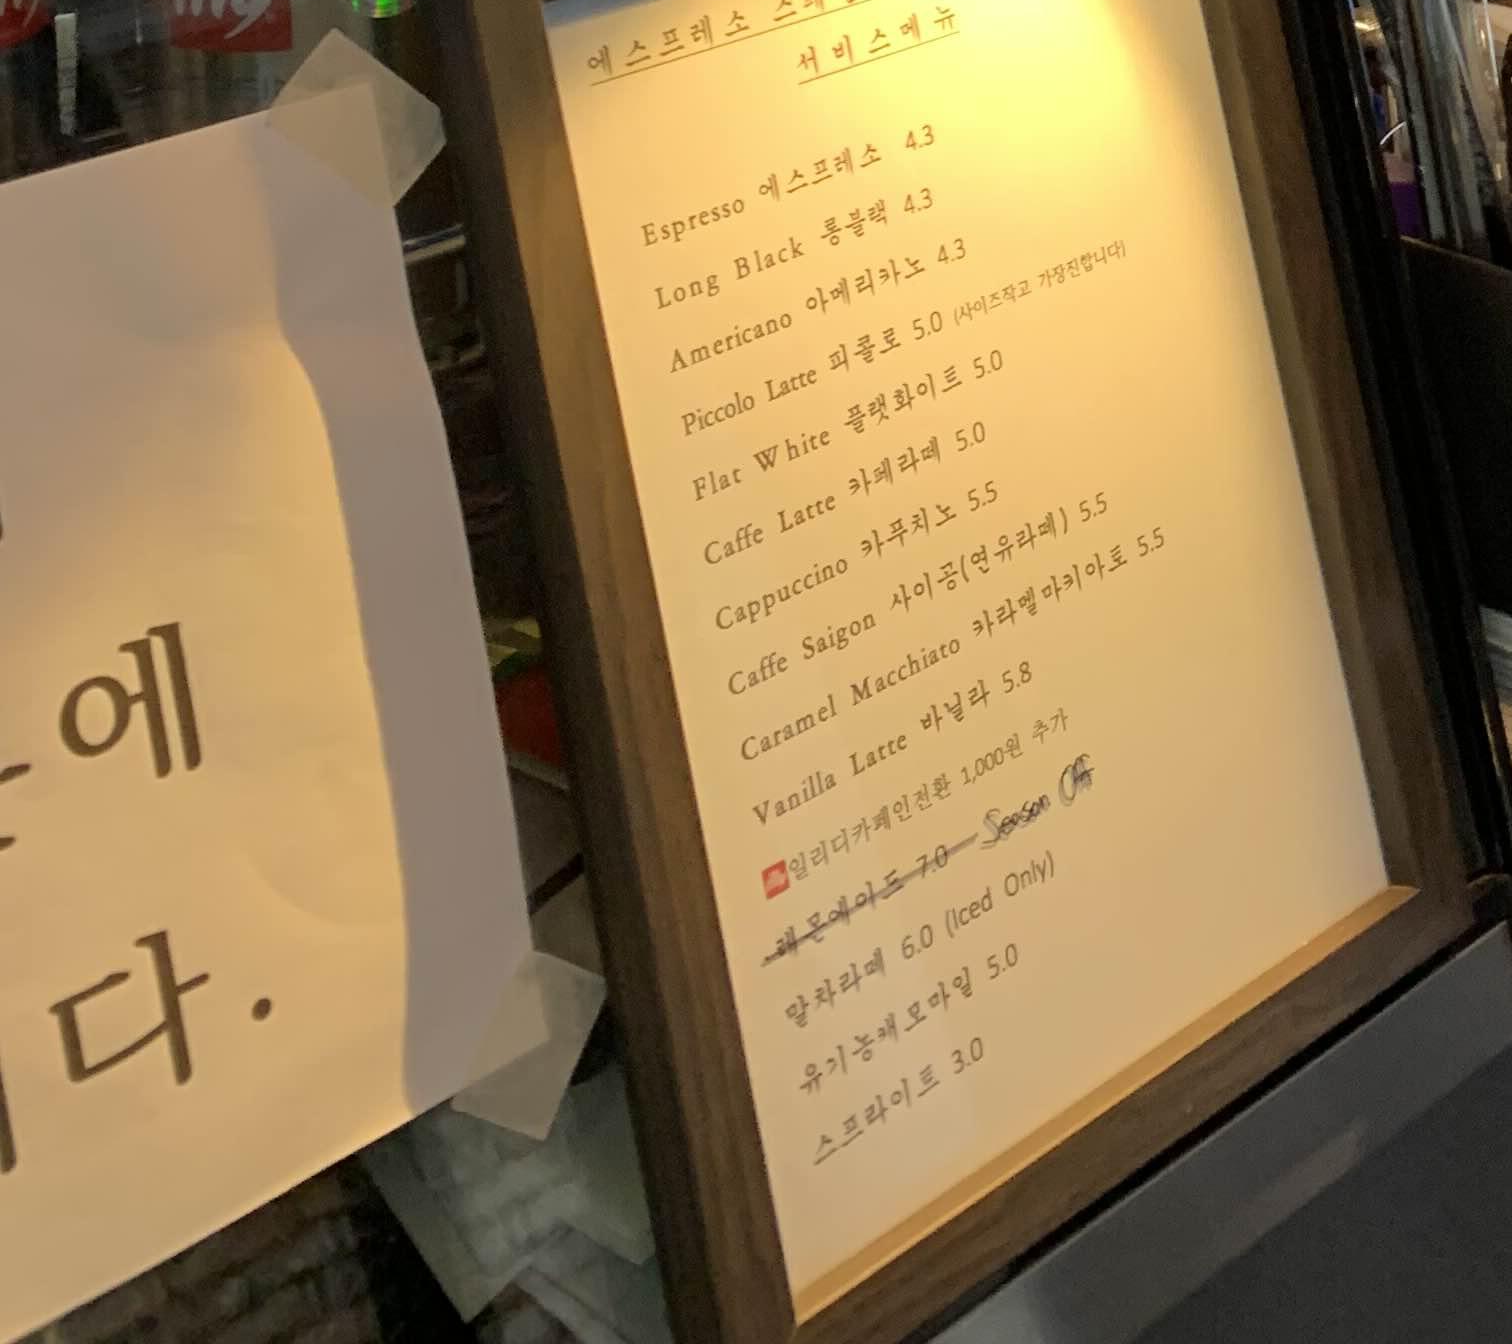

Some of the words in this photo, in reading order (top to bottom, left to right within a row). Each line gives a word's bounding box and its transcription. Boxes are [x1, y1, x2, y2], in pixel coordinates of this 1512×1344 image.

[586, 9, 751, 76] 에스프레소
[641, 199, 745, 247] Espresso
[758, 143, 882, 202] 에스프레소
[904, 124, 935, 151] 4.3
[654, 274, 721, 310] Long
[733, 237, 805, 281] Black
[820, 199, 887, 246] 롱블랙
[903, 187, 934, 214] 4.3
[670, 313, 793, 374] Americano
[805, 257, 926, 315] 아메리카노
[936, 238, 967, 265] 4.3
[681, 391, 756, 437] Piccolo
[763, 368, 818, 402] Latte
[827, 327, 902, 372] 피콜로
[912, 310, 944, 341] 5.0
[953, 279, 1033, 327] (사이즈작고
[692, 467, 743, 502] Flat
[752, 429, 831, 473] White
[844, 365, 963, 434] 플랫화이트
[973, 349, 1004, 379] 5.0
[703, 522, 764, 565] Caffe
[776, 495, 837, 534] Latte
[848, 435, 941, 496] 카페라떼
[954, 421, 986, 452] 5.0
[714, 558, 849, 631] Cappuccino
[859, 503, 957, 558] 카푸치노
[966, 480, 998, 512] 5.5
[727, 651, 789, 696] Caffe
[801, 613, 877, 660] Saigon
[1078, 491, 1108, 523] 5.5
[740, 693, 838, 761] Caramel
[849, 637, 961, 706] Macchiato
[972, 544, 1128, 638] 카라멜마키아토
[1136, 526, 1165, 558] 5.5
[752, 770, 838, 827] Vanilla
[849, 733, 909, 777] Latte
[920, 679, 991, 734] 바닐라
[1001, 660, 1033, 694] 5.8
[788, 772, 952, 881] 일리디카페인전환
[960, 732, 1024, 785] 1,000원
[1032, 707, 1069, 744] 추가
[915, 844, 948, 879] 7.0
[980, 794, 1051, 849] Season
[784, 946, 886, 1029] 말차라떼
[900, 923, 935, 960] 6.0
[944, 886, 994, 939] (Iced
[1003, 849, 1056, 898] Only)
[799, 966, 975, 1095] 유기농캐모마일
[986, 943, 1019, 981] 5.0
[812, 1063, 941, 1167] 스프라이트
[951, 1036, 985, 1075] 3.0
